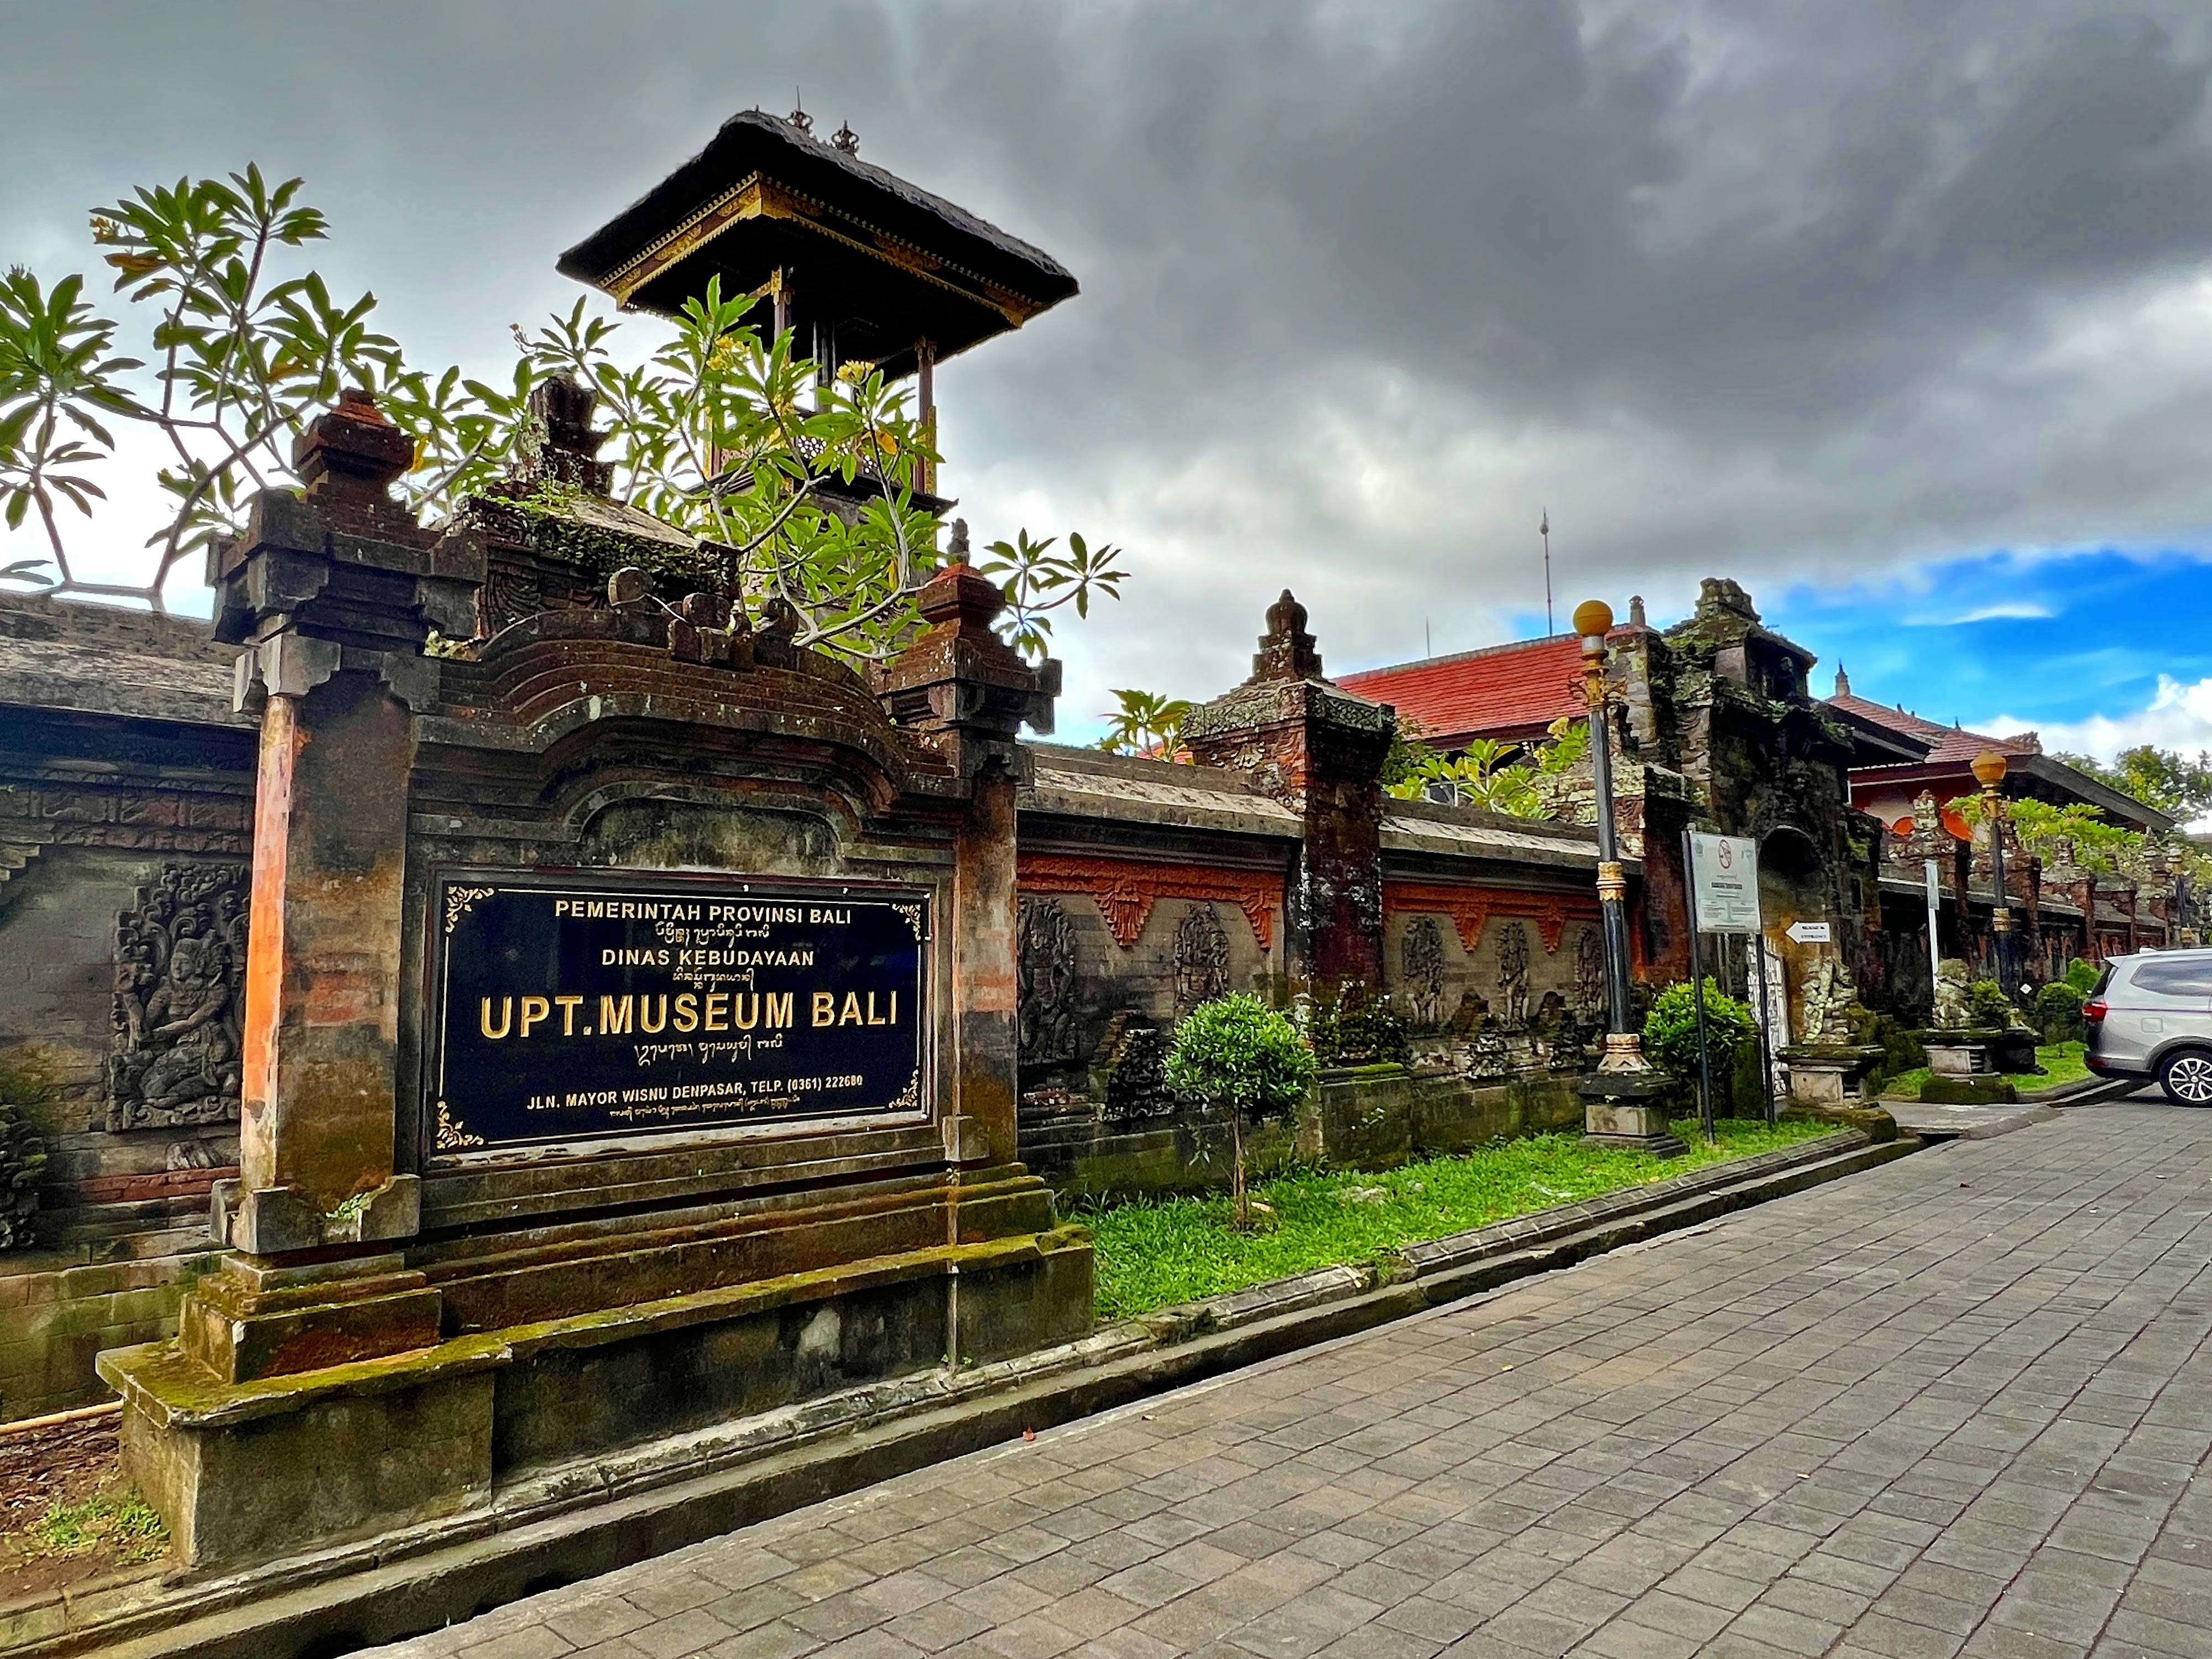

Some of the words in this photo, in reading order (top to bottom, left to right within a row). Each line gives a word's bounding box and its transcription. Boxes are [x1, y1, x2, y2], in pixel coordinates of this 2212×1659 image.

[555, 900, 701, 921] PEMERINTAH
[709, 905, 802, 924] PROVINSI
[810, 909, 851, 924] BALI
[602, 949, 670, 966] DINAS
[679, 950, 814, 966] KEBUDAYAAN
[481, 993, 794, 1039] UPT.MUSEUM
[812, 990, 898, 1028] BALI
[526, 1095, 560, 1110] JLN.
[566, 1091, 617, 1107] MAYOR
[622, 1087, 668, 1102] WISNU
[672, 1082, 747, 1099] DENPASAR,
[750, 1079, 784, 1093] TELP.
[787, 1077, 822, 1093] (0361)
